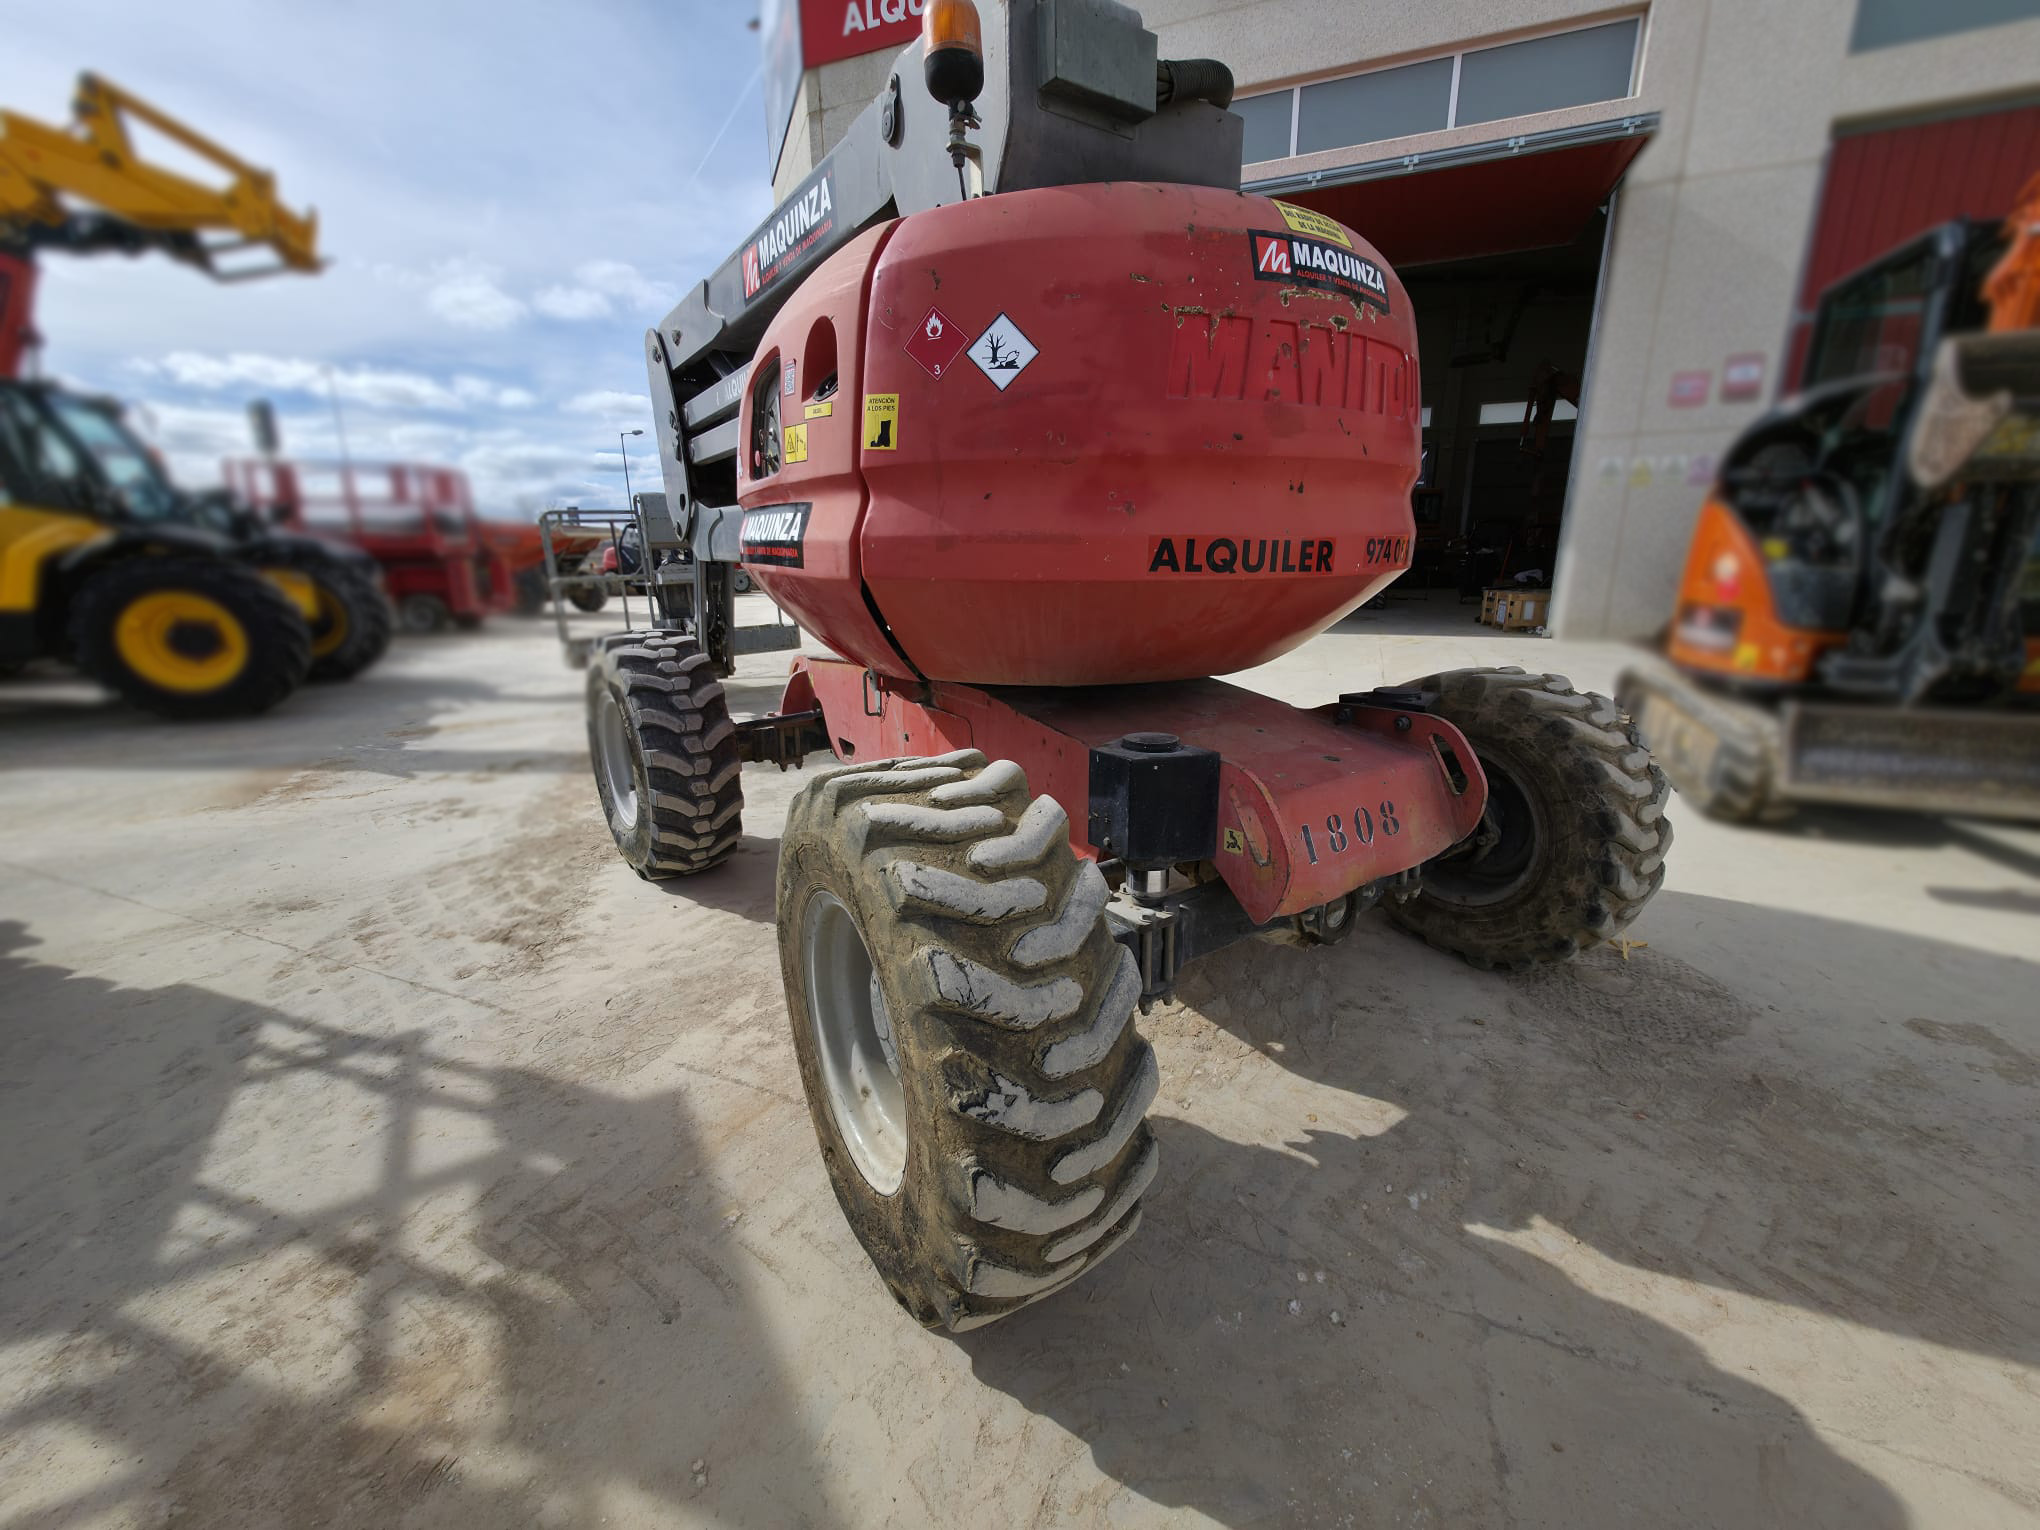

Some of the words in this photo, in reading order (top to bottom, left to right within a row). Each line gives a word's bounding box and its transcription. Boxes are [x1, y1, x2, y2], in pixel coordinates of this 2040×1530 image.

[758, 176, 832, 270] MAQUINZA
[1292, 240, 1386, 294] MAQUINZA
[1296, 268, 1327, 281] ALQUILER
[1333, 275, 1351, 289] VENTA
[934, 363, 941, 376] 3
[868, 396, 895, 404] ATENCIÓN
[882, 404, 896, 412] PIES
[744, 513, 801, 542] MAQUINZA
[1148, 537, 1334, 574] ALQUILER
[1366, 538, 1392, 564] 974
[1300, 799, 1400, 865] 1808
